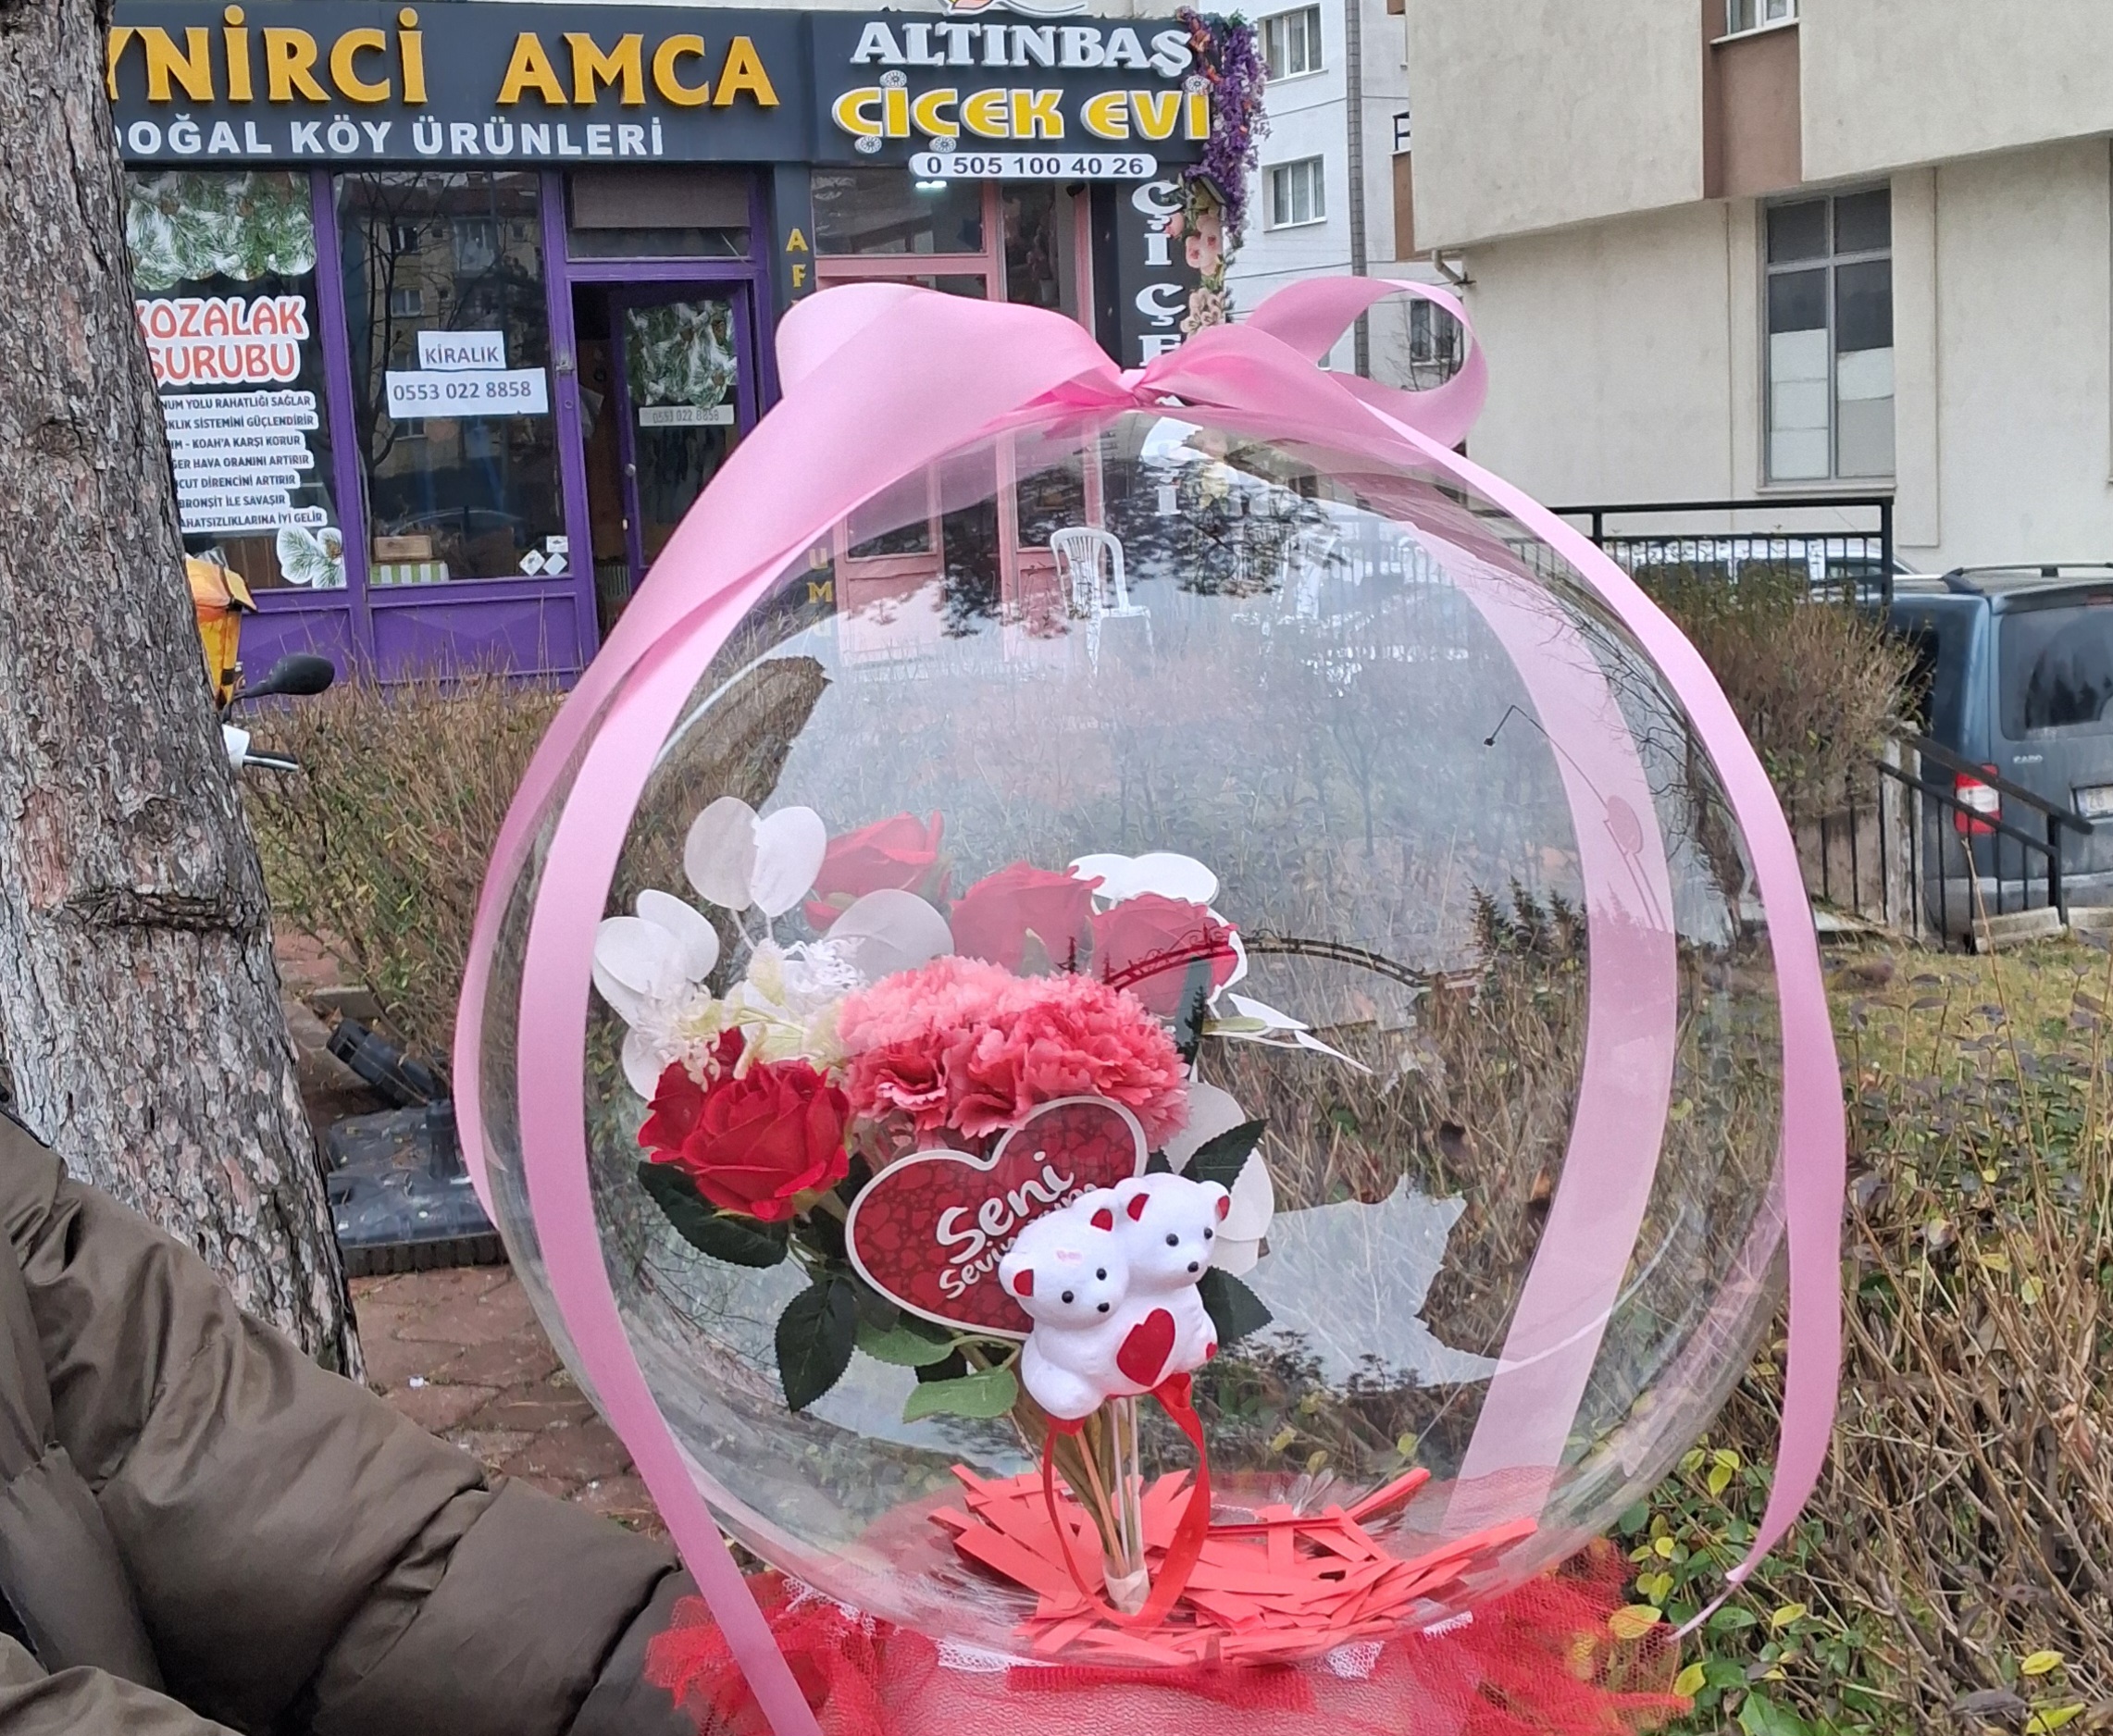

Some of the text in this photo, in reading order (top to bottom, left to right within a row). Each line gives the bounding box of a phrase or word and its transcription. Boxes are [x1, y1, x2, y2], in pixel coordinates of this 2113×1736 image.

[849, 21, 1193, 79] ALTINBAŞ
[496, 31, 780, 106] AMCA
[832, 69, 1212, 155] ÇİÇEK EVİ
[114, 112, 665, 155] OĞAL KÖY ÜRÜNLERİ
[926, 155, 1145, 176] 0 505 100 40 26
[425, 343, 500, 365] KİRALIK
[392, 380, 532, 402] 0553 022 8858
[185, 398, 213, 410] YOLU
[215, 394, 269, 409] RAHATLIĞI
[270, 394, 311, 407] SAĞLAR
[193, 415, 245, 429] SİSTEMİNİ
[246, 413, 315, 428] GÜÇLENDİRİR
[232, 436, 265, 448] KARŞI
[265, 435, 302, 447] KORUR
[193, 457, 222, 469] HAVA
[223, 455, 267, 467] ORANINI
[201, 474, 254, 489] DİRENCİNİ
[225, 494, 241, 507] İLE
[242, 494, 286, 507] SAVAŞIR
[293, 509, 323, 524] GELİR
[937, 1150, 1075, 1265] Seni
